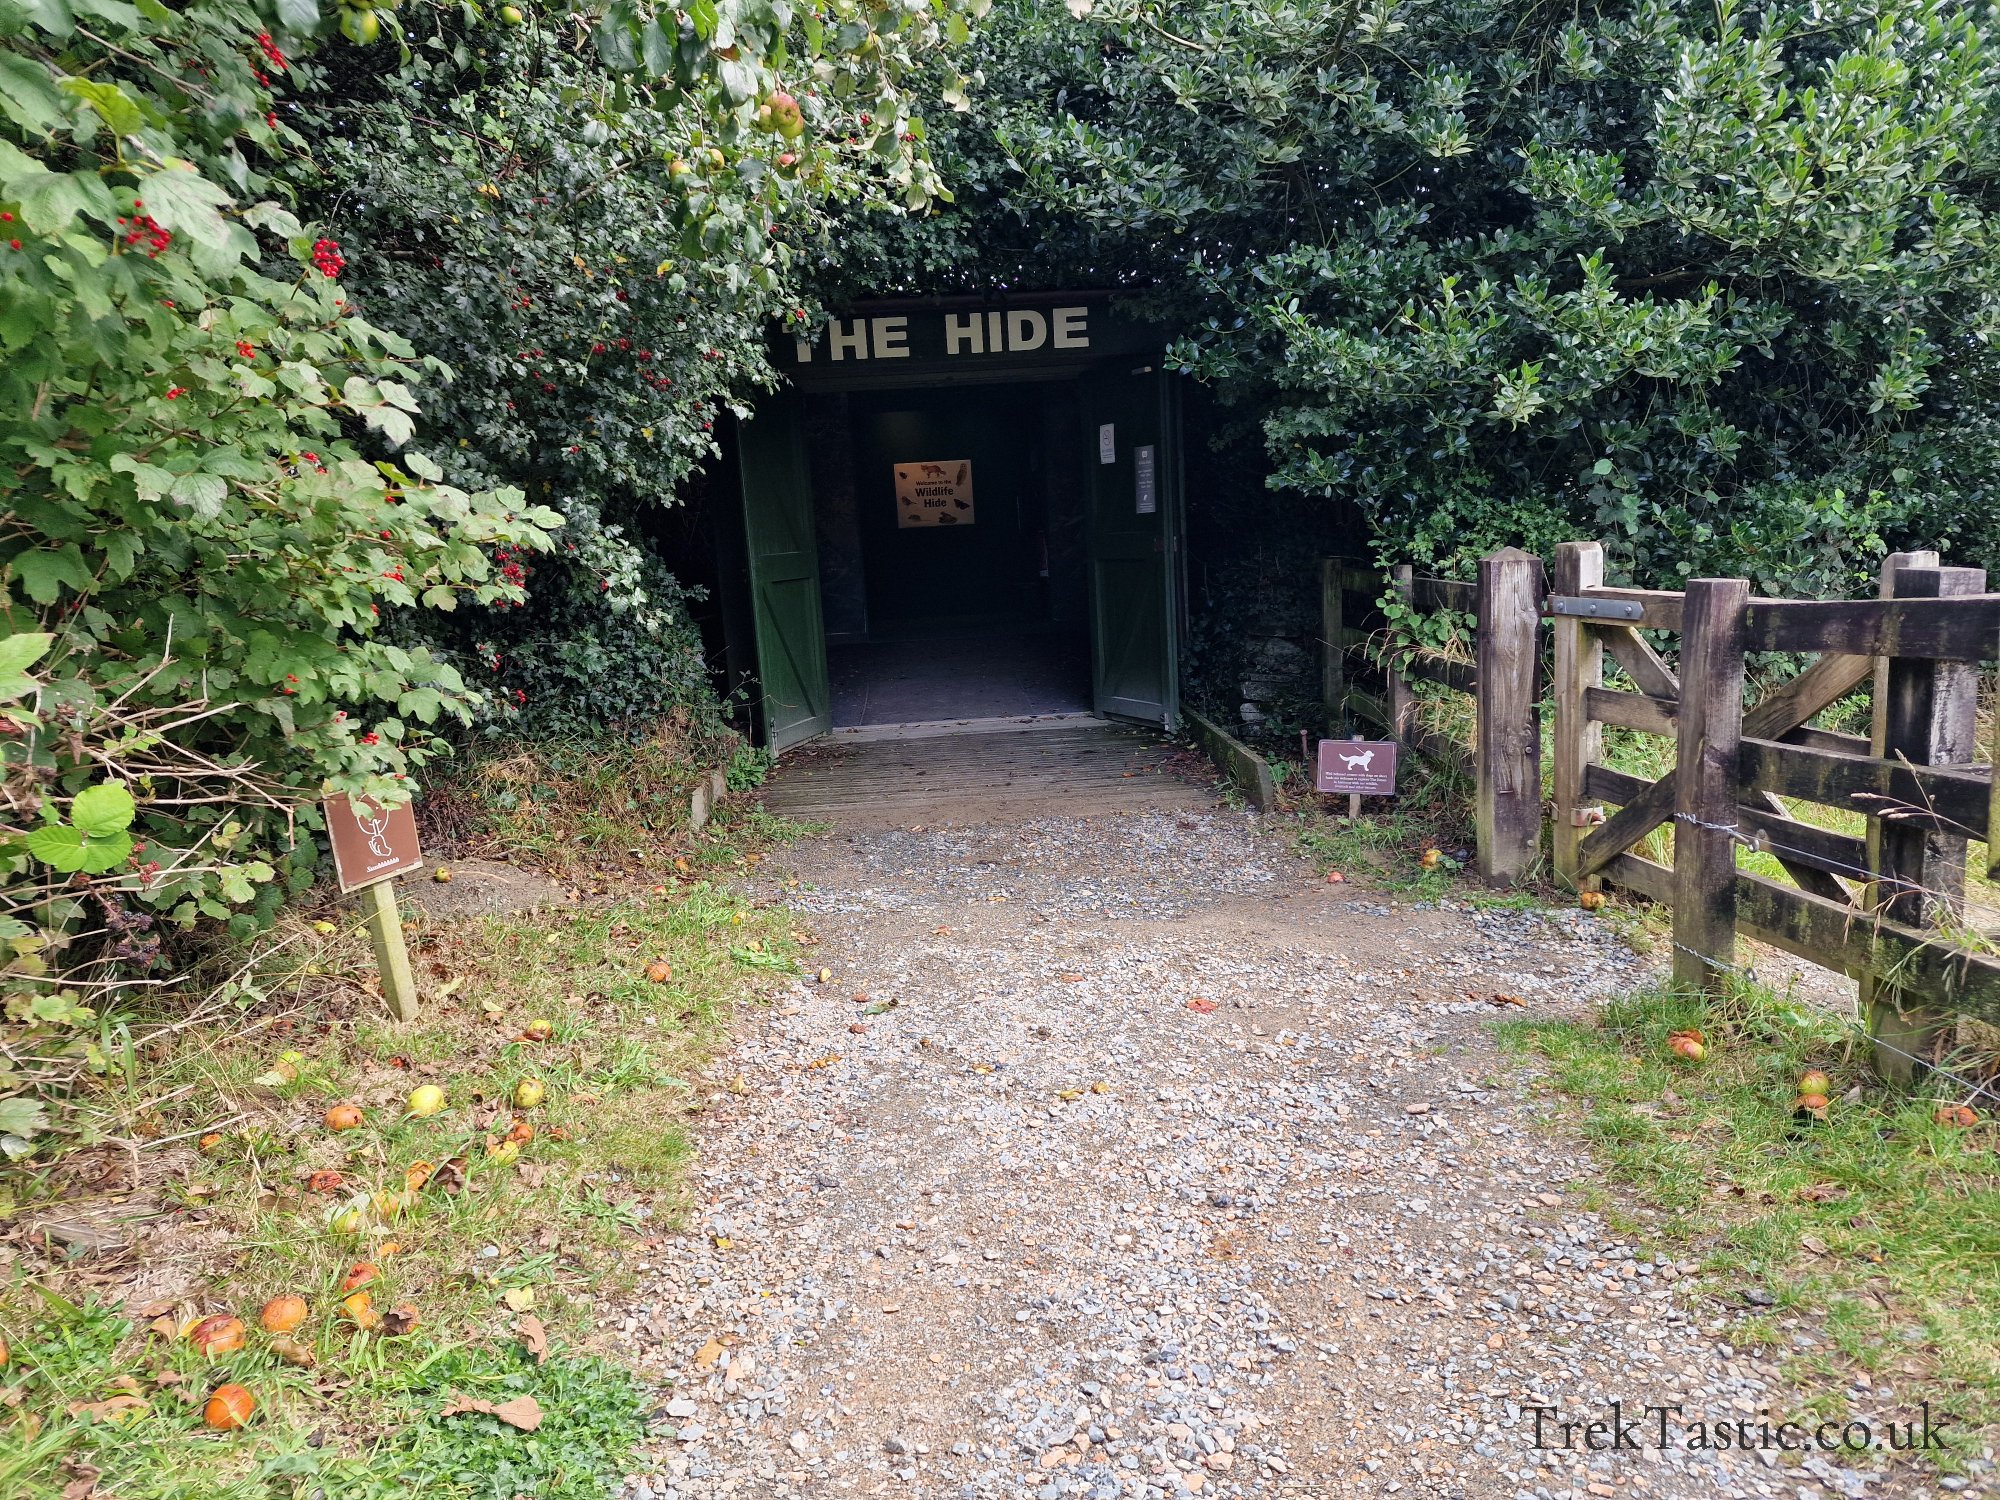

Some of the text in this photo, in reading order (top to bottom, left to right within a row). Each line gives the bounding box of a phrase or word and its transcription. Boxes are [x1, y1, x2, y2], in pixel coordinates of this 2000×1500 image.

[945, 306, 1090, 355] HIDE
[915, 486, 954, 497] Wildlife
[923, 498, 947, 508] Hide
